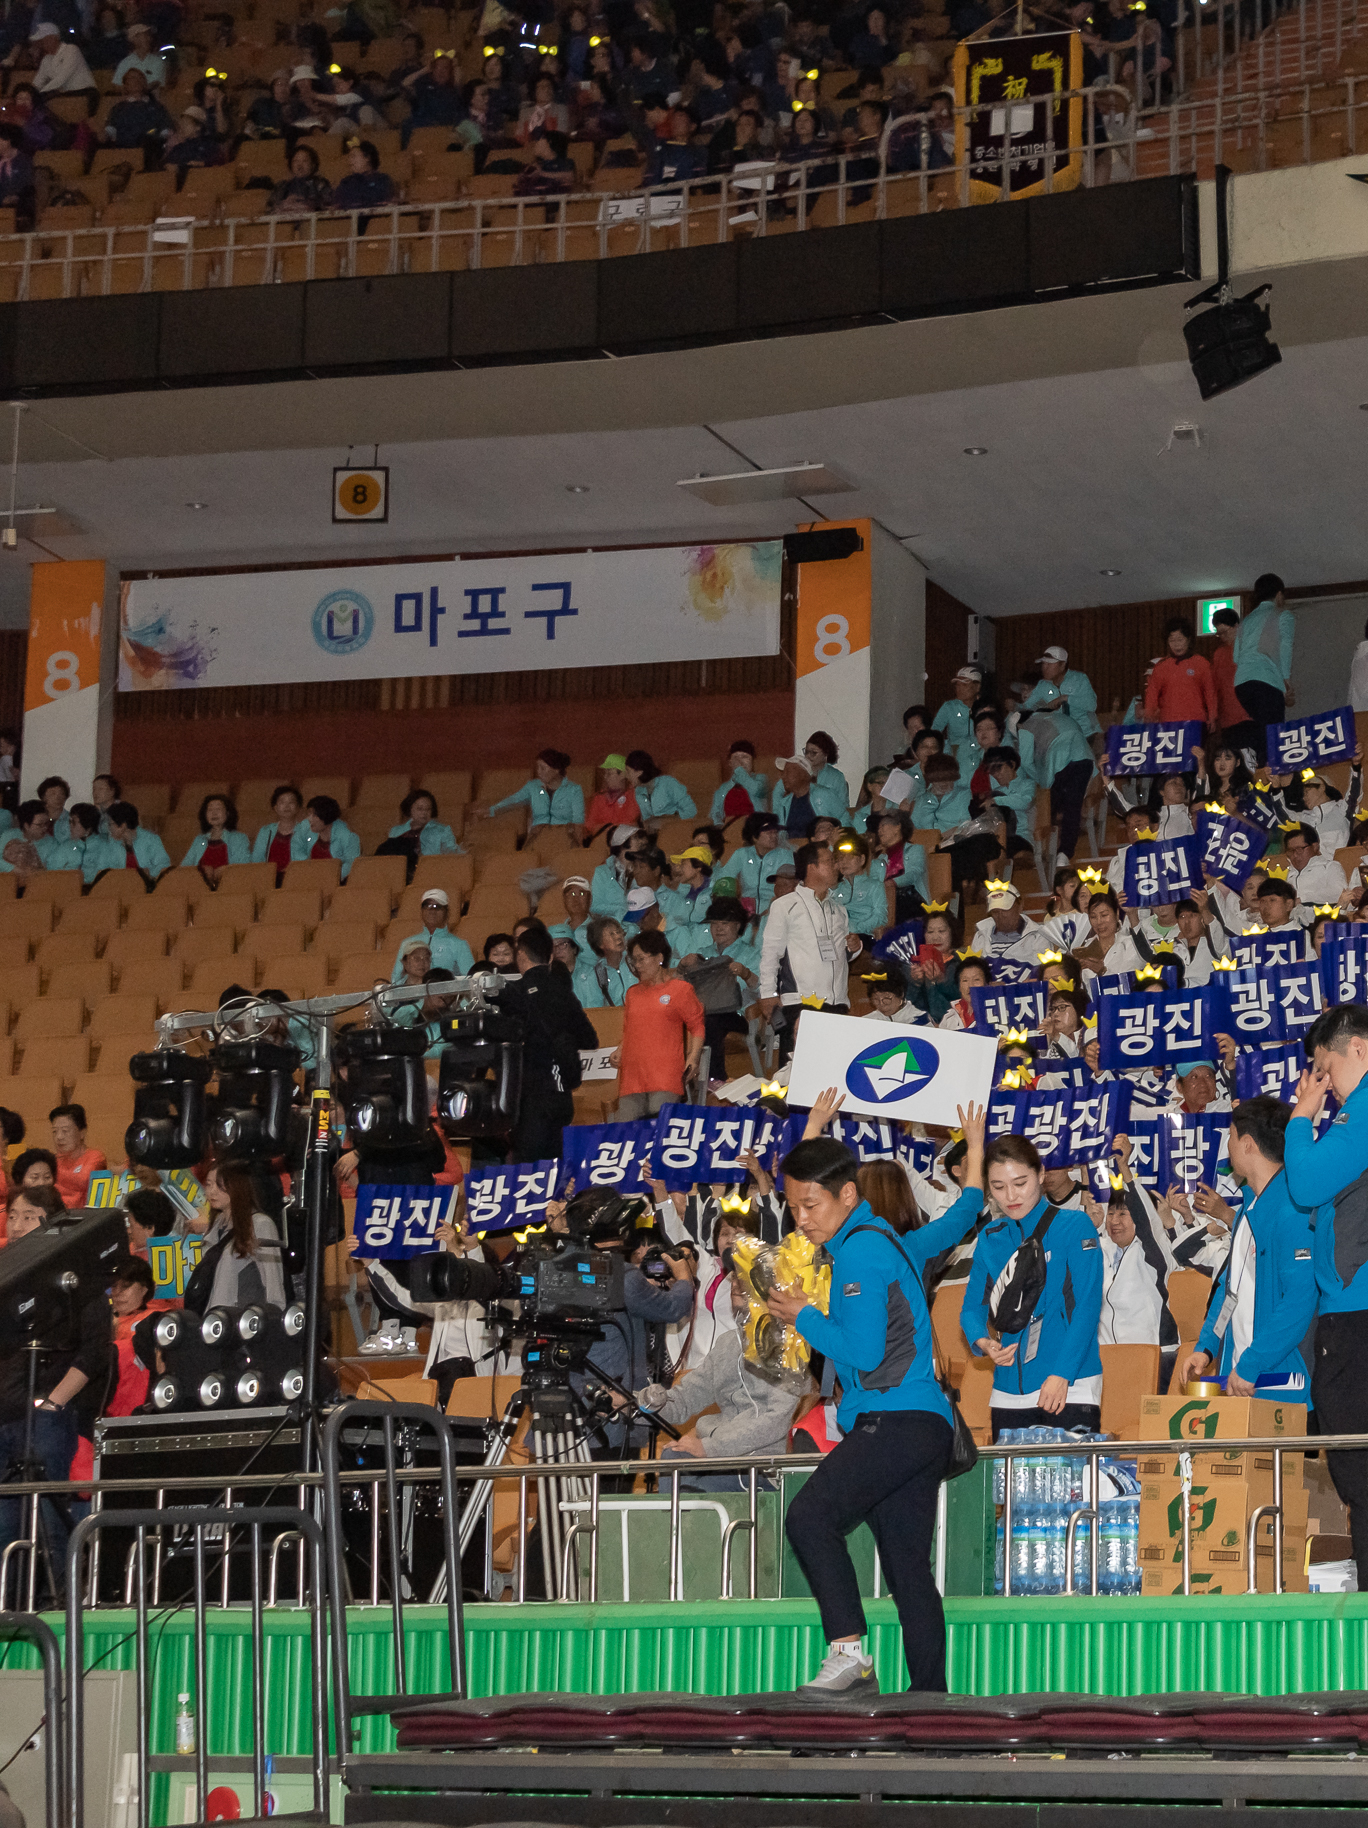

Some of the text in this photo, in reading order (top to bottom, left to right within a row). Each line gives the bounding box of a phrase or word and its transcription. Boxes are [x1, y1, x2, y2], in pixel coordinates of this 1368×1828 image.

[353, 485, 367, 504] 8
[394, 581, 578, 647] 마포구
[814, 613, 851, 664] 8
[43, 650, 80, 699] 8
[1119, 728, 1185, 767] 광진
[1279, 716, 1346, 764] 광진
[1115, 997, 1203, 1056] 광진
[1231, 972, 1322, 1032] 광진
[661, 1117, 754, 1169] 광진
[1024, 1093, 1110, 1156] 광진
[468, 1165, 559, 1223] 광진
[364, 1197, 442, 1247] 광진
